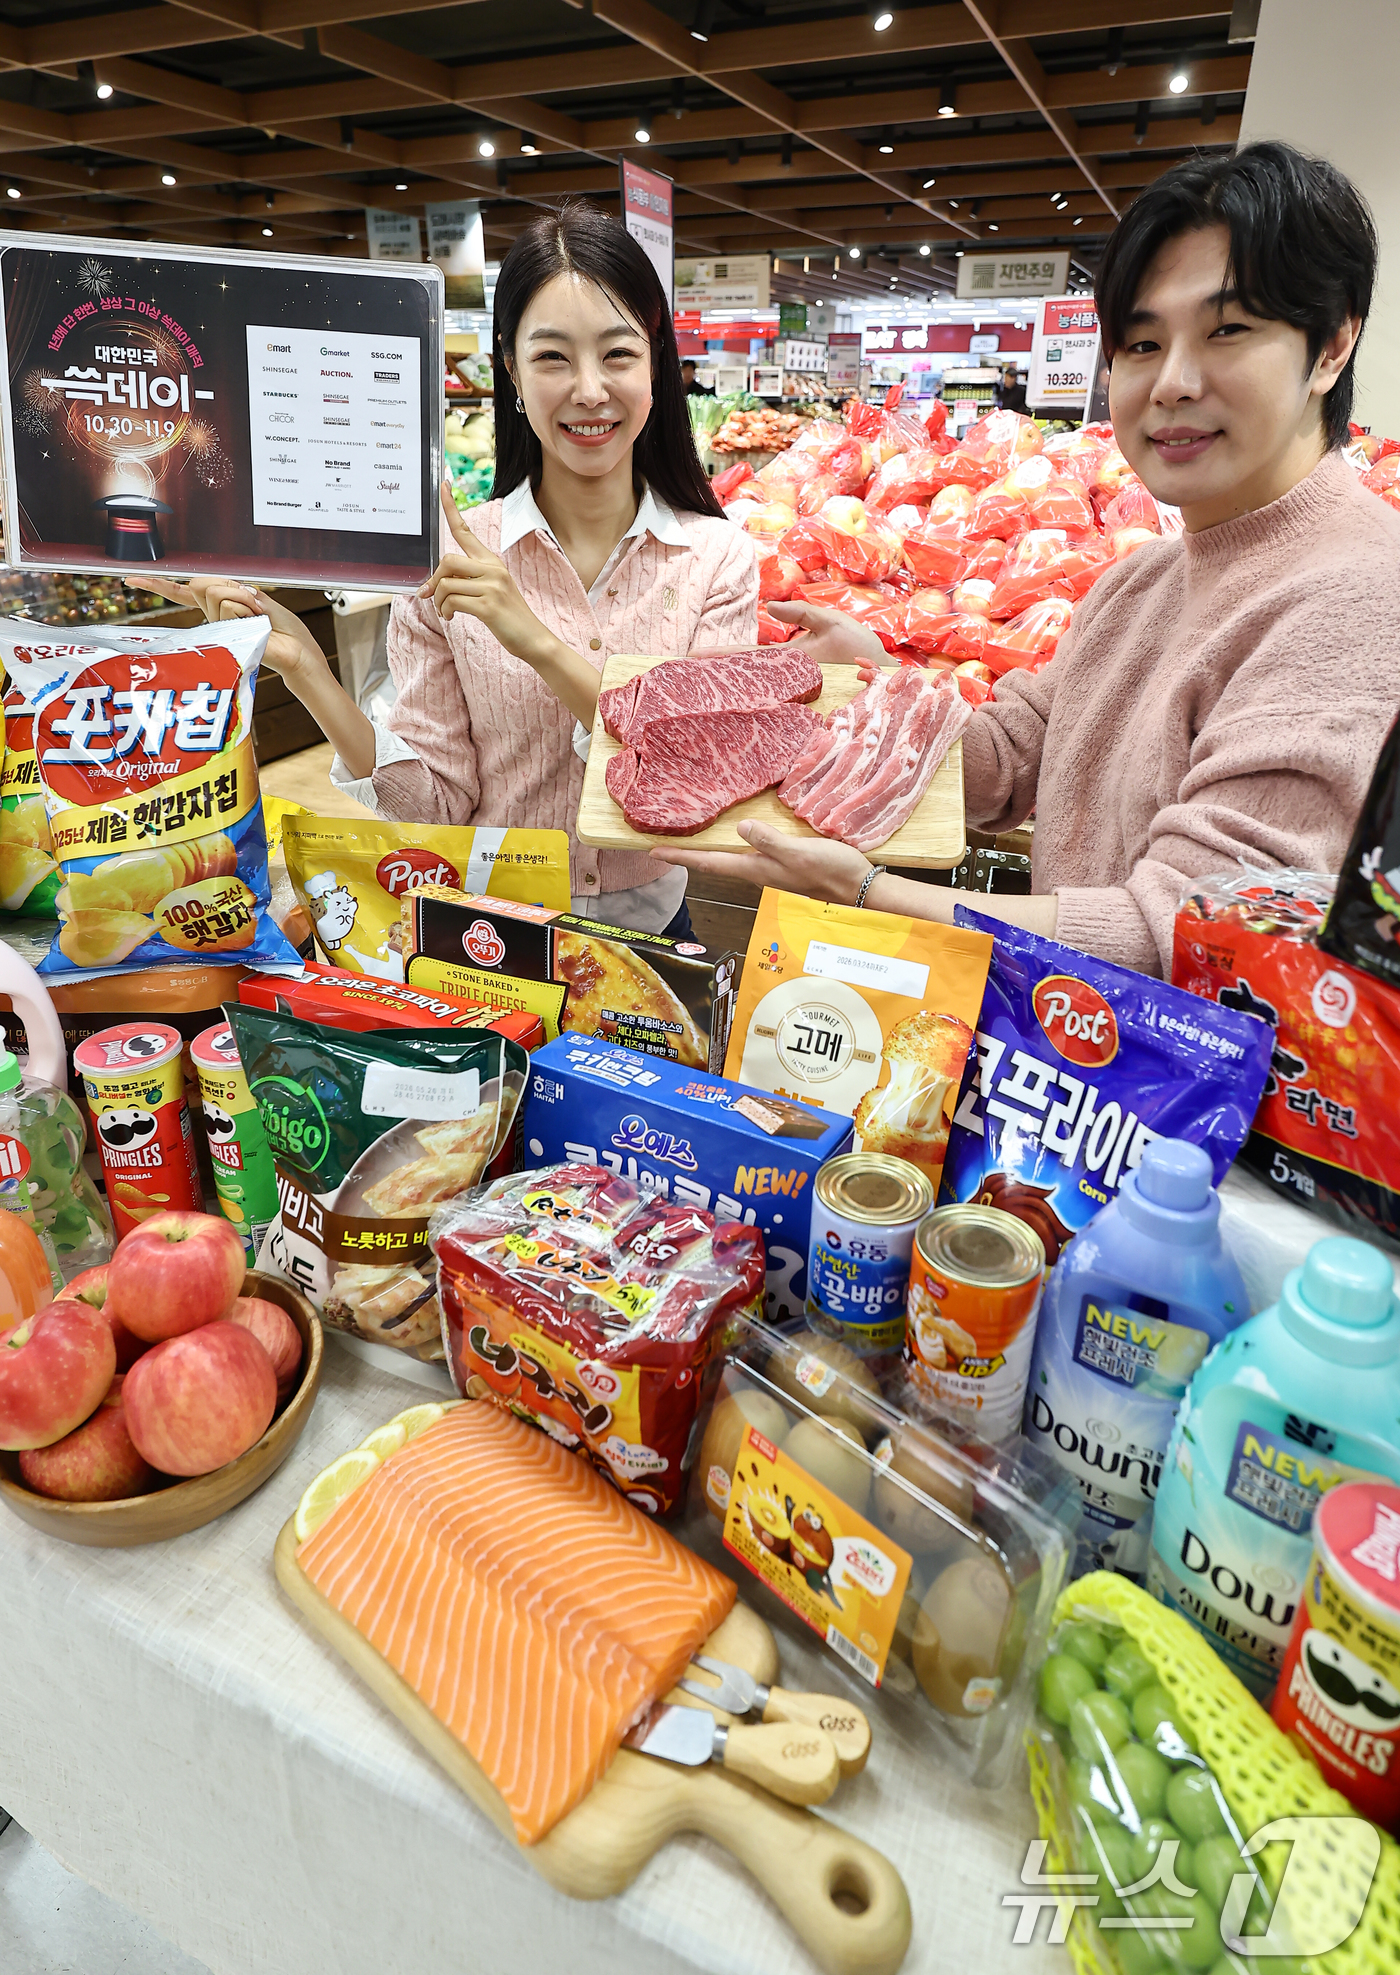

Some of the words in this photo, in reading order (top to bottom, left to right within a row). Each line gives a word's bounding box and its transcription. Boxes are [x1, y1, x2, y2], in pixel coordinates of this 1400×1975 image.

[48, 324, 68, 351] 1년에
[62, 314, 77, 328] 단
[100, 297, 122, 311] 상상
[124, 297, 136, 311] 그
[138, 301, 161, 320] 이상
[161, 314, 191, 346] 쓱데이
[185, 343, 204, 369] 매직
[94, 345, 158, 367] 대한민국
[267, 343, 291, 354] emart
[320, 347, 350, 357] Gmarket
[371, 352, 402, 360] SSG.COM
[262, 366, 297, 374] SHINSEGAE
[375, 372, 399, 380] TRADERS
[1046, 373, 1083, 387] 10,320
[263, 391, 298, 399] STARBUCKS
[376, 442, 402, 450] emart24
[374, 463, 403, 471] casamia
[33, 645, 98, 660] 오리온
[42, 682, 235, 765] 포카칩
[115, 758, 181, 781] Original
[85, 810, 129, 844] 제철
[133, 769, 238, 841] 햇감자칩
[480, 851, 514, 864] 좋은아침!
[515, 853, 549, 865] 좋은생각!
[161, 899, 217, 927] 100%
[213, 884, 243, 909] 국산
[180, 904, 251, 949] 햇감자
[472, 942, 497, 959] 오뚜기
[761, 948, 771, 958] CJ
[453, 971, 481, 985] STONE
[483, 977, 513, 992] BAKED
[342, 990, 377, 1003] SINCE
[380, 997, 408, 1010] 1974
[439, 980, 481, 1002] TRIPLE
[484, 991, 527, 1013] CHEESE
[616, 1013, 636, 1025] 고소한
[1043, 990, 1110, 1045] Post
[668, 1049, 678, 1058] 맛!
[786, 1023, 843, 1062] 고메
[565, 1049, 662, 1088] 쿠키앤크림
[806, 1064, 829, 1074] CUISINE
[533, 1091, 555, 1104] HAITAI
[1286, 1086, 1358, 1139] 라면
[611, 1114, 698, 1172] 오예스
[101, 1142, 163, 1168] PRINGLES
[115, 1173, 153, 1181] ORIGINAL
[734, 1165, 808, 1199] NEW!
[1270, 1152, 1316, 1198] 5개입
[1078, 1178, 1107, 1205] Corn
[341, 1230, 409, 1251] 노릇하고
[848, 1240, 889, 1263] 유동
[815, 1245, 861, 1281] 자연산
[1086, 1303, 1167, 1350] NEW
[1080, 1341, 1135, 1384] 프레시
[469, 1325, 613, 1436] 너구리
[1242, 1434, 1341, 1494] NEW
[1181, 1526, 1295, 1628] Dow
[1289, 1662, 1395, 1776] PRINGLES
